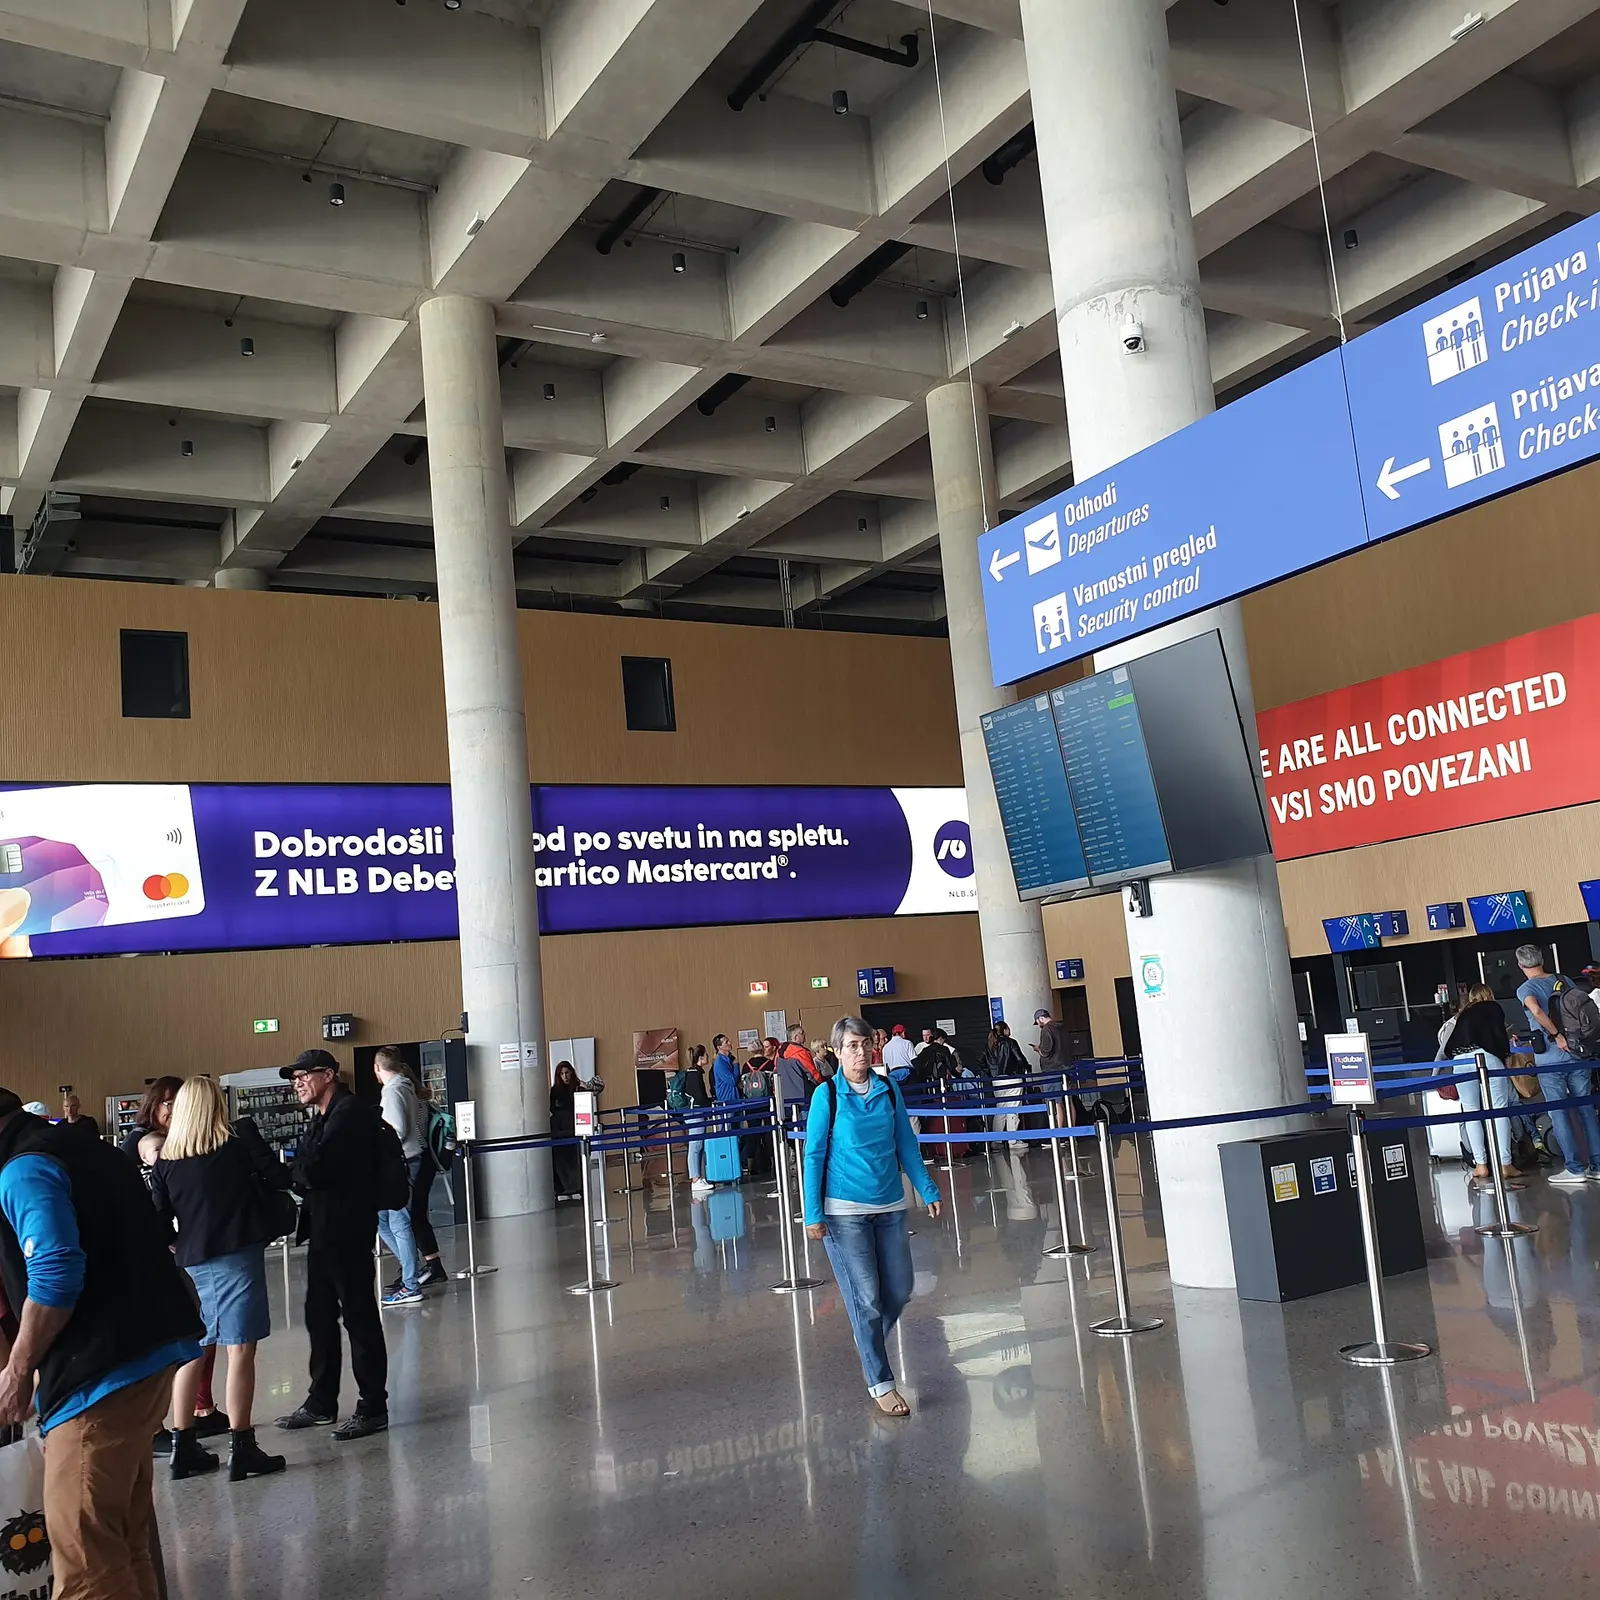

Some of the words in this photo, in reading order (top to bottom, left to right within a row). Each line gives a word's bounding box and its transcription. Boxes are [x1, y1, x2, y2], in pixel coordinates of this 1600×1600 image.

[1494, 250, 1588, 314] Prijava
[1501, 278, 1600, 352] Check-i
[1064, 482, 1117, 526] Odhodi
[1067, 503, 1150, 557] Departures
[1073, 556, 1148, 607] Varnostni
[1152, 525, 1217, 579] pregled
[1077, 595, 1139, 638] Security
[1143, 566, 1200, 611] control
[1260, 749, 1272, 778] E
[1278, 734, 1327, 774] ARE
[1333, 721, 1382, 760] ALL
[1387, 671, 1567, 746] CONNECTED
[1270, 788, 1313, 824] VSI
[1319, 774, 1376, 815] SMO
[1382, 737, 1532, 802] POVEZANI
[253, 826, 444, 859] Dobrodošli
[573, 830, 611, 857] po
[617, 826, 692, 850] svetu
[697, 823, 723, 849] in
[729, 828, 763, 848] na
[768, 822, 850, 853] spletu.
[254, 869, 279, 897] Z
[288, 866, 359, 896] NLB
[368, 863, 457, 894] Debe
[535, 858, 620, 887] artico
[1450, 912, 1456, 926] 4
[1515, 896, 1524, 907] A
[1520, 914, 1528, 925] 4
[1362, 917, 1371, 929] A
[1367, 934, 1375, 945] 3
[1373, 922, 1382, 936] 3
[1392, 920, 1400, 934] 3
[1430, 915, 1438, 929] 4
